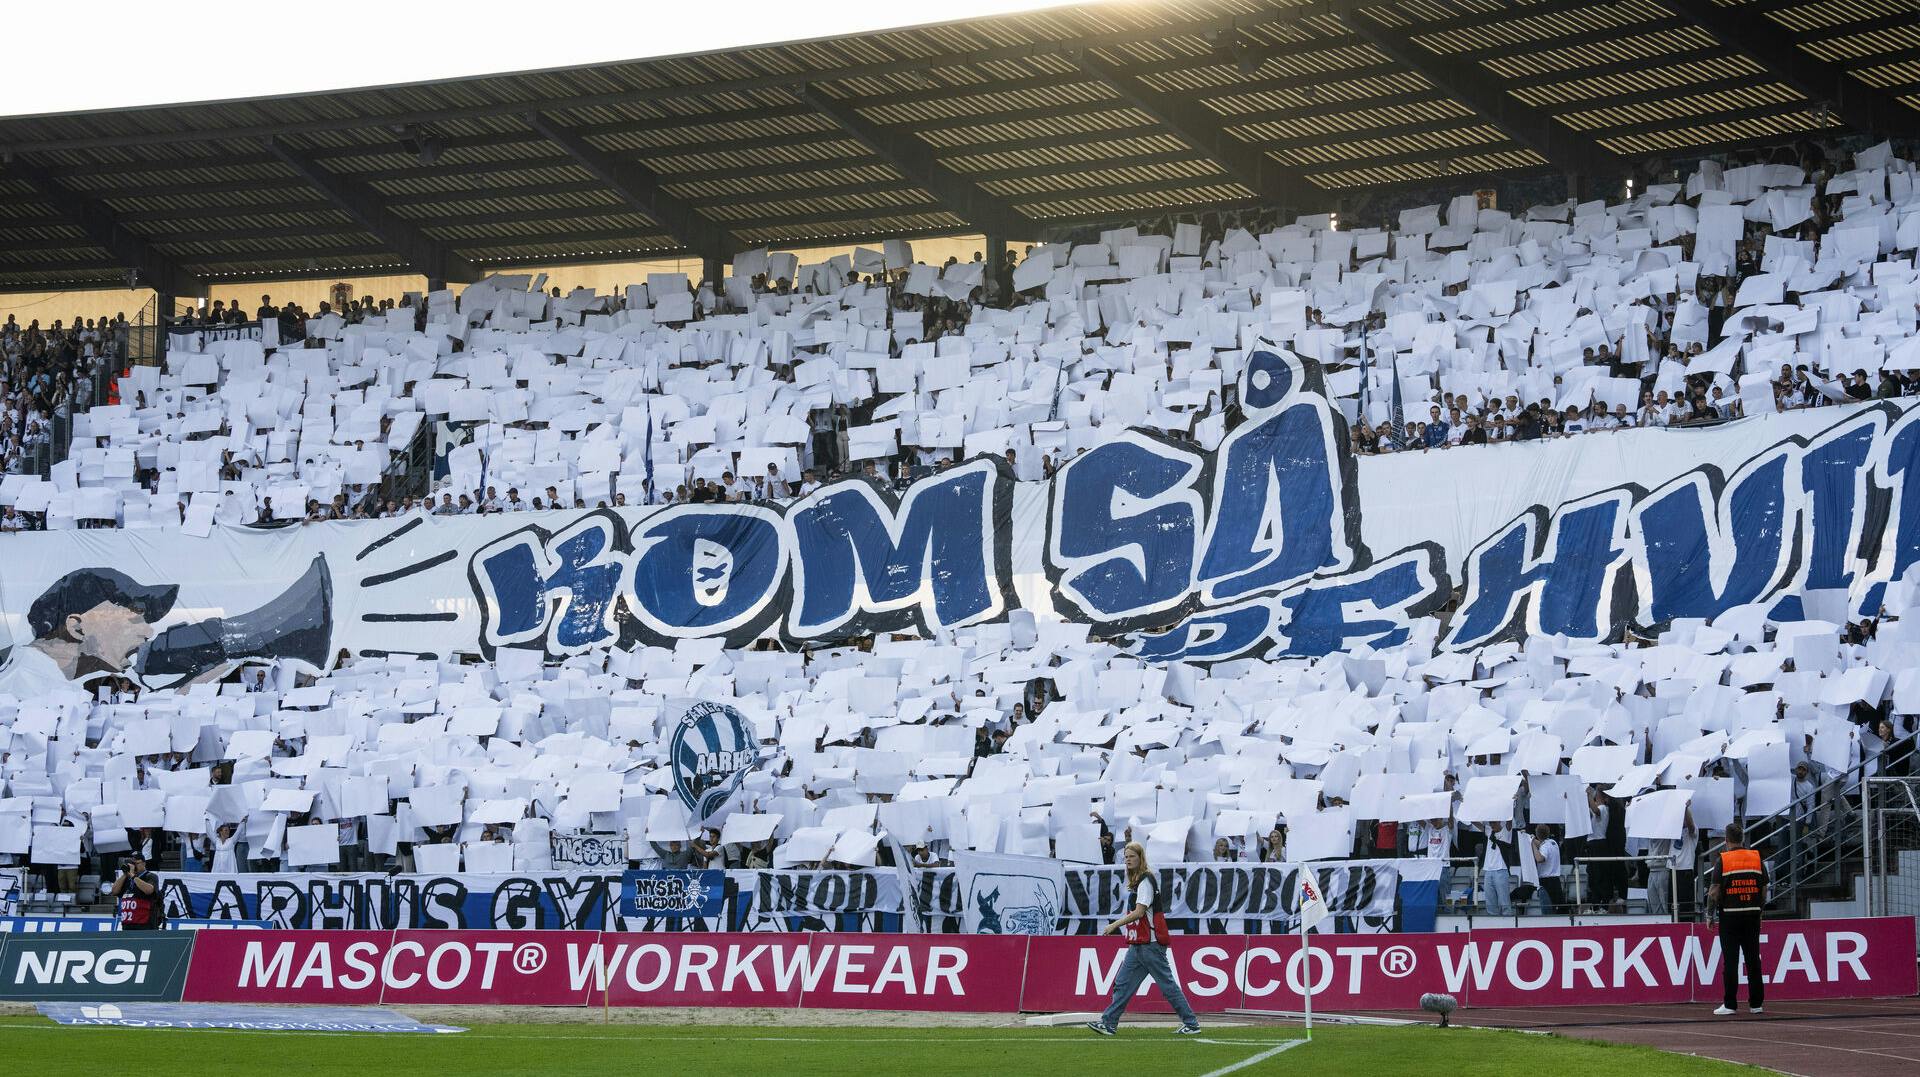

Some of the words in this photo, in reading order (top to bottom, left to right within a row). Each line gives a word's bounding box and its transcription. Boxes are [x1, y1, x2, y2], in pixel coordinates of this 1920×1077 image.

[470, 455, 1012, 660] KOM
[1047, 340, 1368, 634] SÅ
[121, 900, 137, 910] OTO
[162, 877, 467, 930] AARHUS
[15, 949, 151, 985] NRGi
[567, 943, 968, 996] WORKWEAR
